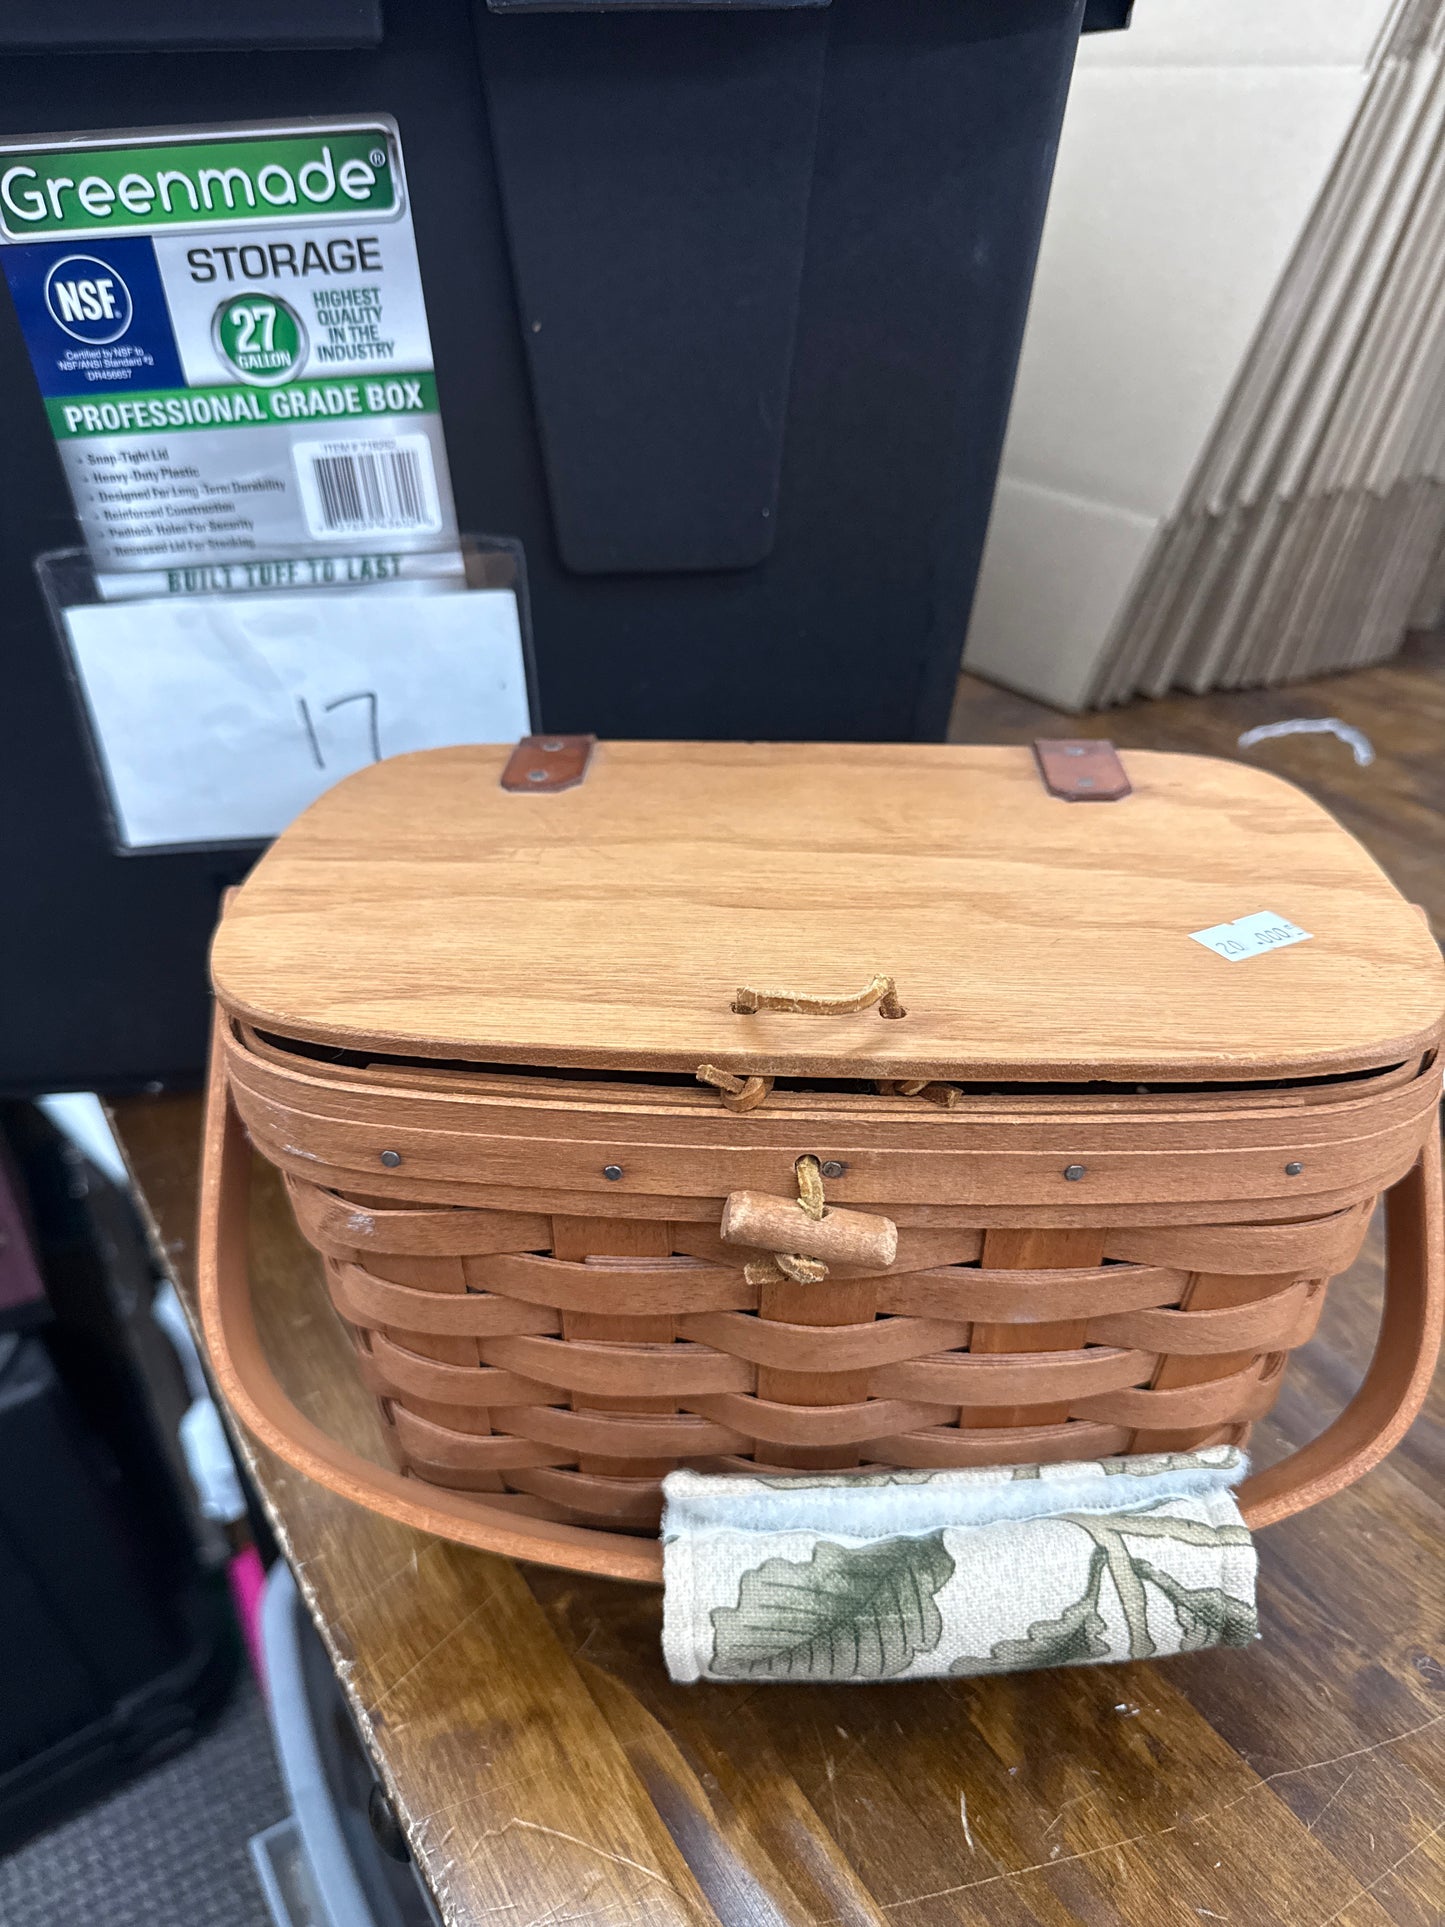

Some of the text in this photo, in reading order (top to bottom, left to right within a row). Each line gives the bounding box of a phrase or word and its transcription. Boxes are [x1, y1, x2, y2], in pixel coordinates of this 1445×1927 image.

[187, 237, 383, 284] STORAGE
[312, 287, 381, 309] HIGHEST
[317, 307, 383, 327] QUALITY
[229, 304, 276, 352] 27
[328, 324, 380, 344] IN THE
[65, 348, 101, 360] Certified
[102, 347, 113, 360] by
[113, 345, 133, 357] NSF
[237, 351, 291, 370] GALLON
[317, 341, 395, 363] INDUSTRY
[103, 357, 143, 368] Standard
[63, 381, 424, 433] PROFESSIONAL GRADE BOX
[151, 448, 169, 461] Lid
[160, 466, 200, 480] Plastic
[98, 487, 151, 504] Designed
[231, 479, 286, 494] Durability
[103, 502, 236, 522] Reinforced Construction
[108, 524, 153, 539] Padlock
[155, 521, 188, 536] Holes
[208, 518, 254, 533] Security
[207, 535, 256, 550] Stacking
[168, 554, 401, 593] BUILT TUFF TO LAST
[298, 692, 383, 769] 17
